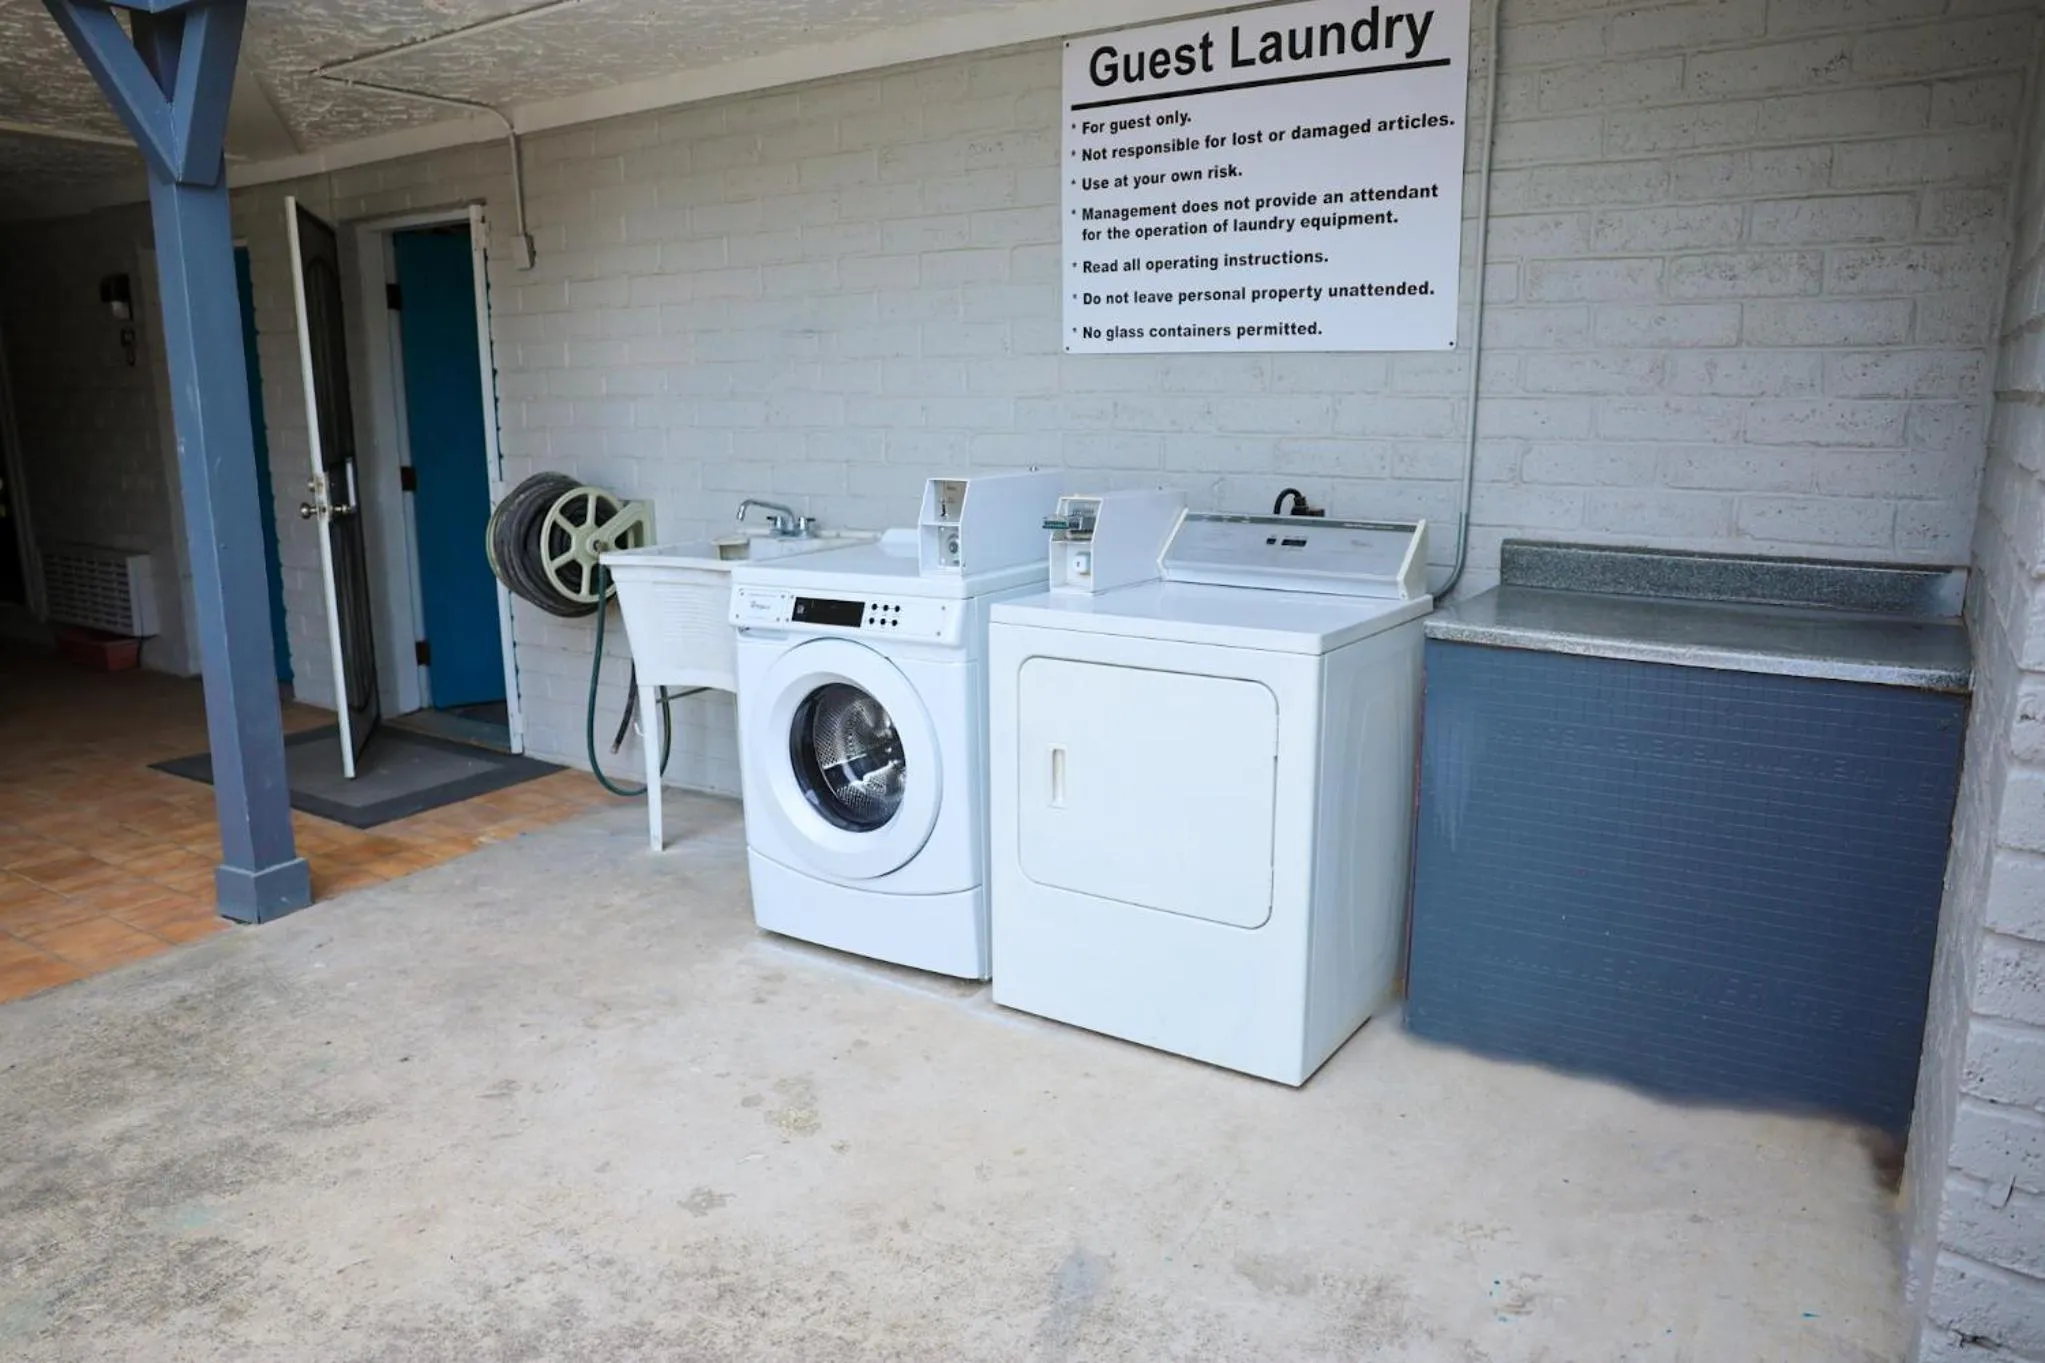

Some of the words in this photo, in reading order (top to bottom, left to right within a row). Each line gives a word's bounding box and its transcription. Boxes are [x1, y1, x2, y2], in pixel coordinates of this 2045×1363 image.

[1089, 31, 1214, 87] Guest
[1230, 6, 1435, 69] Laundry
[1083, 122, 1105, 134] For
[1110, 115, 1150, 134] guest
[1156, 110, 1191, 126] only.
[1082, 148, 1107, 161] Not
[1112, 138, 1199, 159] responsible
[1205, 135, 1226, 148] for
[1233, 131, 1262, 145] lost
[1269, 131, 1285, 142] or
[1292, 119, 1371, 139] damaged
[1378, 113, 1455, 131] articles.
[1082, 178, 1109, 190] Use
[1114, 175, 1128, 187] at
[1134, 174, 1166, 189] your
[1171, 170, 1202, 182] own
[1208, 164, 1242, 178] risk.
[1082, 202, 1176, 221] Management
[1182, 200, 1218, 213] does
[1224, 197, 1250, 210] not
[1256, 192, 1317, 212] provide
[1323, 193, 1343, 204] an
[1350, 184, 1438, 202] attendant
[1082, 229, 1101, 240] for
[1107, 226, 1130, 239] the
[1135, 222, 1207, 240] operation
[1213, 219, 1228, 232] of
[1234, 216, 1295, 232] laundry
[1301, 211, 1398, 231] equipment.
[1083, 260, 1118, 273] Read
[1123, 258, 1140, 271] all
[1146, 255, 1218, 273] operating
[1224, 250, 1328, 266] instructions.
[1084, 293, 1101, 304] Do
[1107, 292, 1128, 304] not
[1134, 291, 1173, 303] leave
[1179, 287, 1245, 304] personal
[1252, 286, 1322, 303] property
[1329, 281, 1434, 297] unattended.
[1083, 327, 1101, 338] No
[1107, 326, 1144, 341] glass
[1149, 324, 1231, 337] containers
[1237, 322, 1322, 339] permitted.
